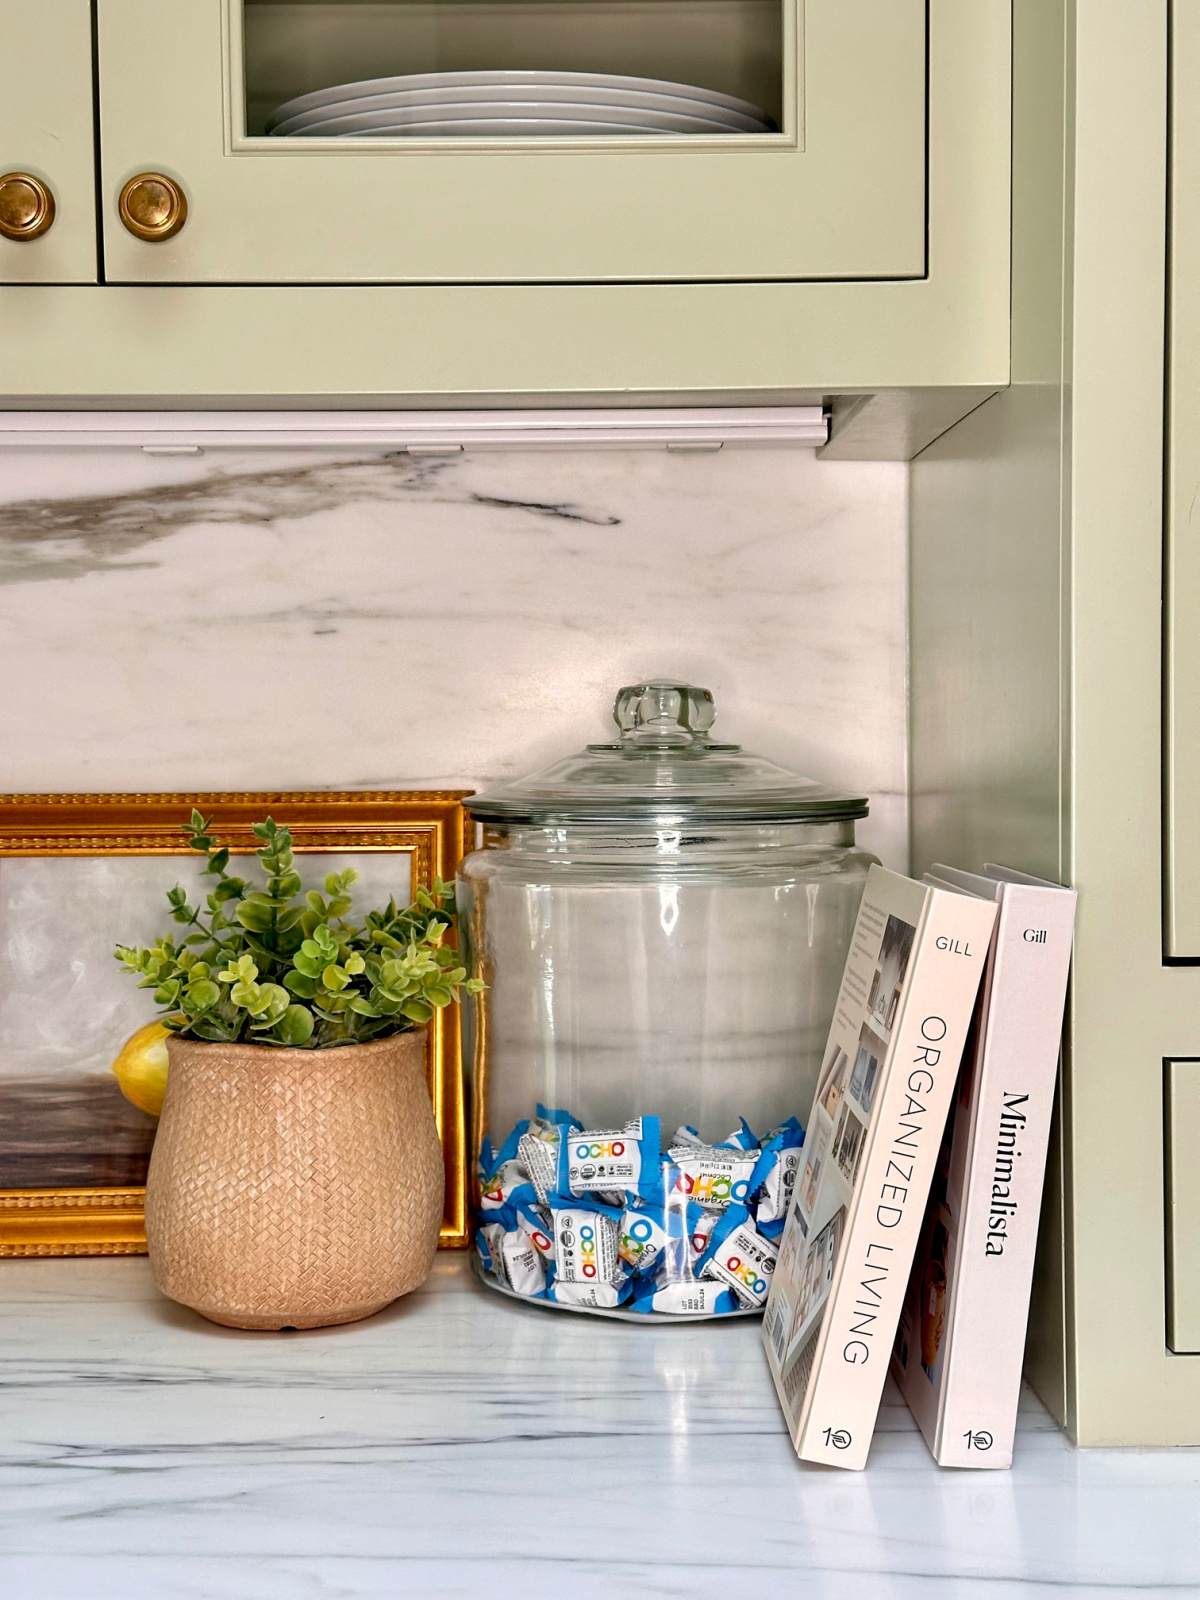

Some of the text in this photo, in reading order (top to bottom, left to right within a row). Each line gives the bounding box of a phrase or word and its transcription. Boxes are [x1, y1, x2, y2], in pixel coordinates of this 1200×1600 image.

[935, 936, 972, 957] GILL
[1023, 929, 1047, 944] Gill
[576, 1141, 625, 1160] OCHO
[700, 1172, 732, 1184] Coconut
[984, 1091, 1030, 1257] Minimalista
[675, 1173, 751, 1202] OCHO
[843, 1015, 947, 1365] ORGANIZED LIVING
[687, 1194, 733, 1208] Organic
[580, 1225, 597, 1278] OCHO
[726, 1256, 767, 1295] OCHO
